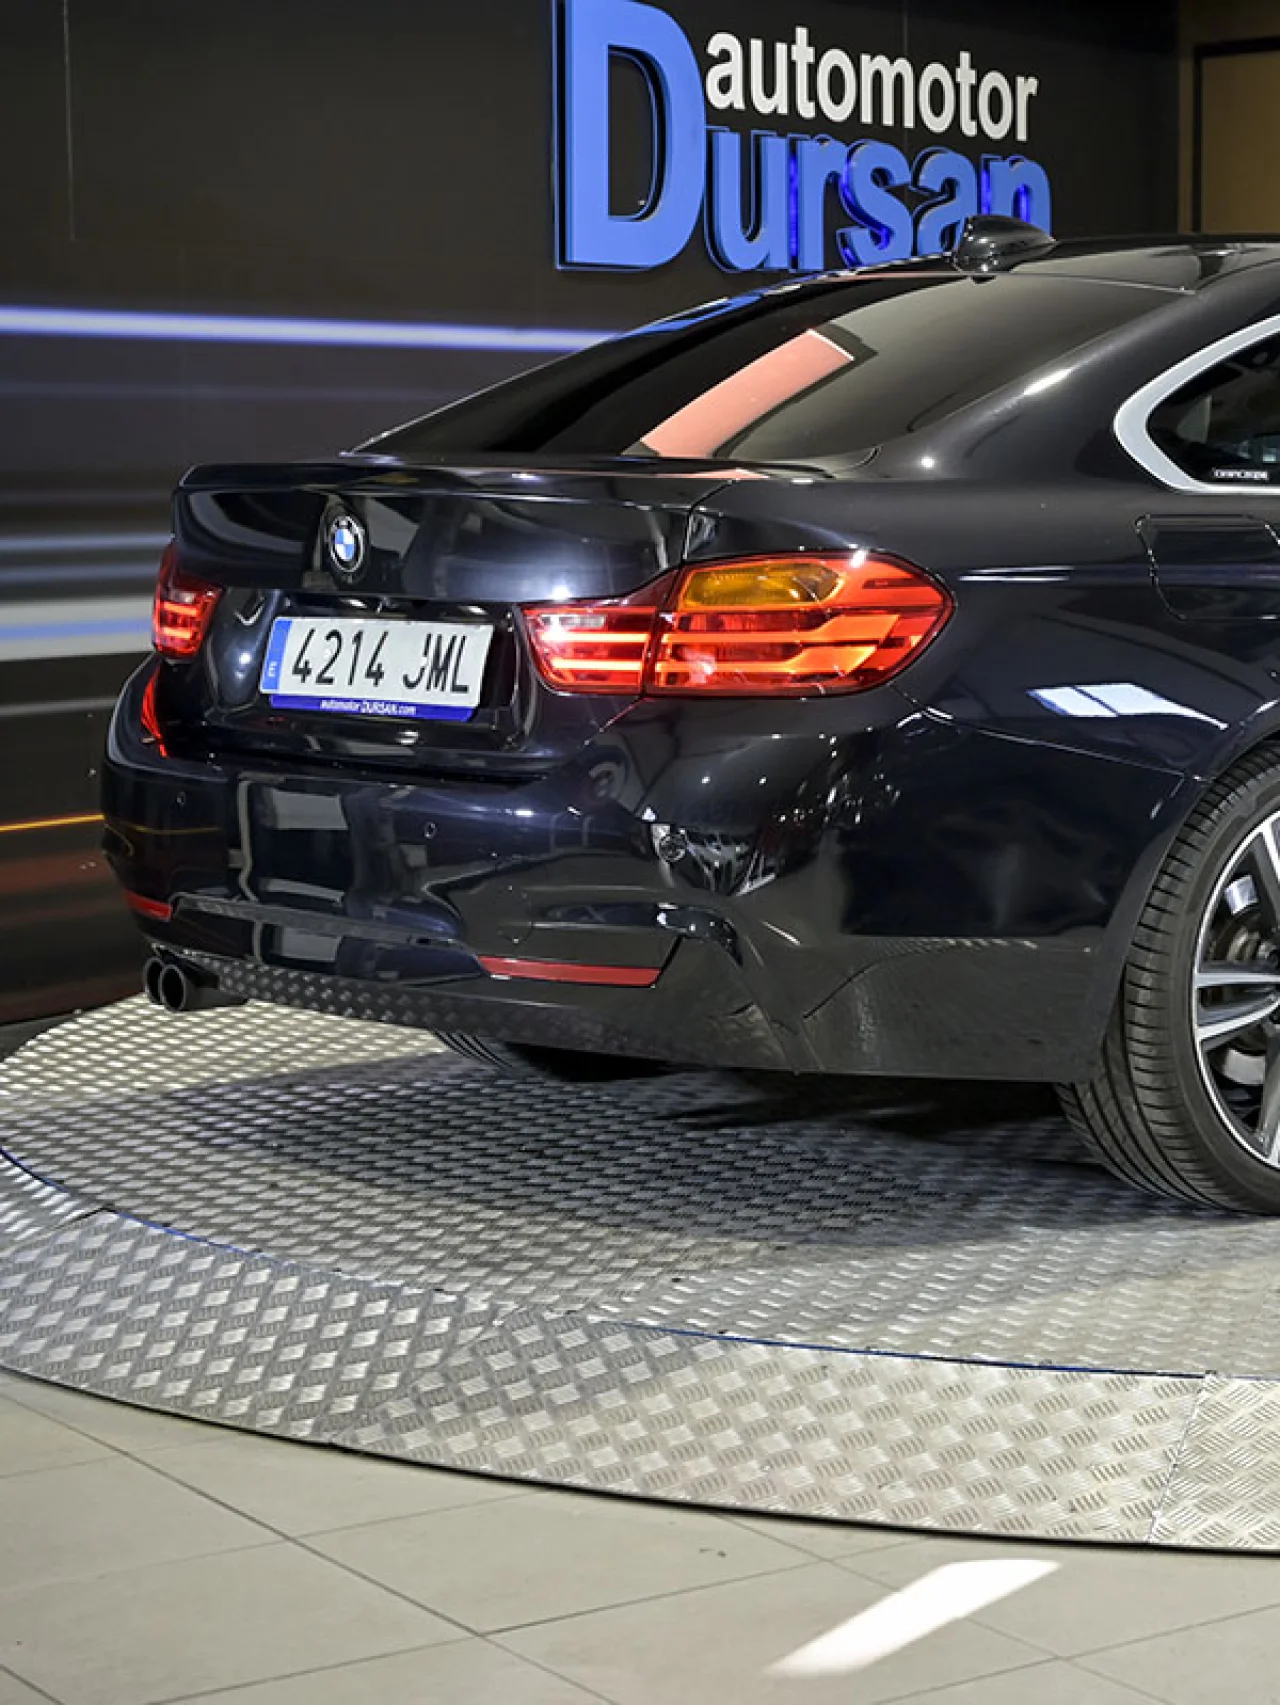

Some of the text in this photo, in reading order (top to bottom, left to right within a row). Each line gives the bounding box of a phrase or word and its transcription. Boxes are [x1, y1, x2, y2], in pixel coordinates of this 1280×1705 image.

[553, 0, 1052, 272] Dursan
[705, 27, 1038, 142] automotor
[292, 628, 470, 693] 4214 JML
